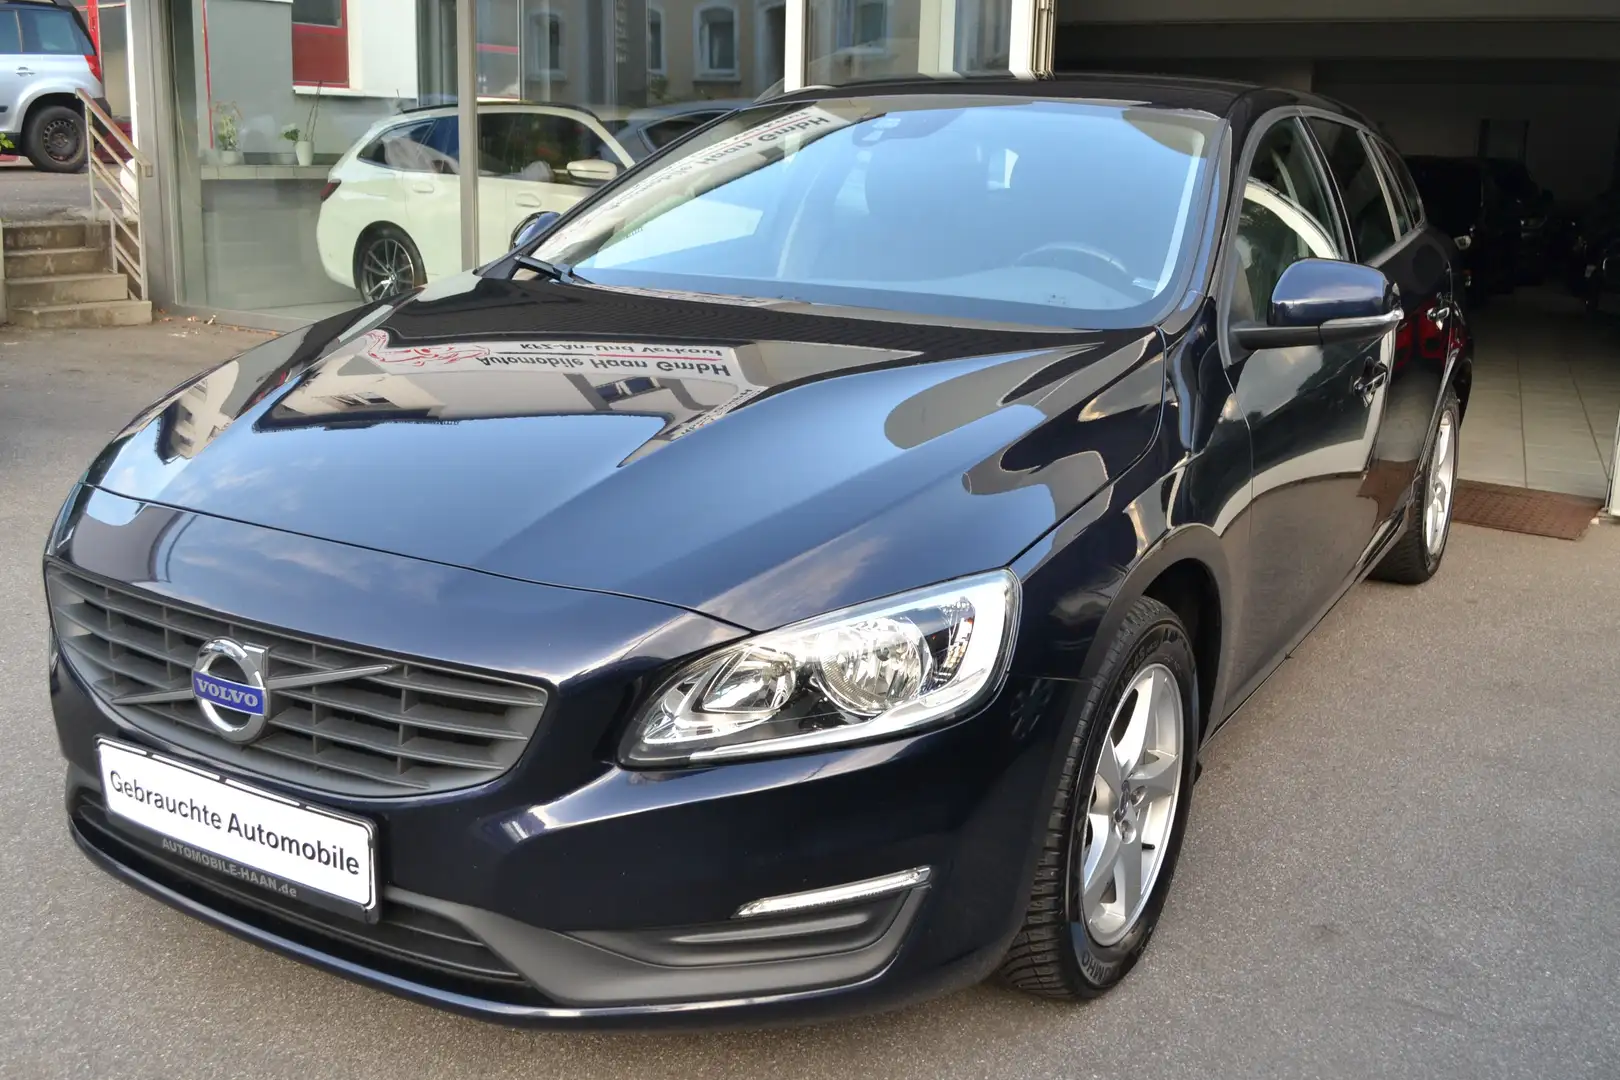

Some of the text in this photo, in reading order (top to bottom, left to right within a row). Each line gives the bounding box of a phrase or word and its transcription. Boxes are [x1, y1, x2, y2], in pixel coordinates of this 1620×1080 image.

[195, 677, 259, 707] VOLVO
[110, 770, 360, 875] Gebrauchte Automobile
[162, 838, 297, 897] AUTOMOBILE-HAAN.de
